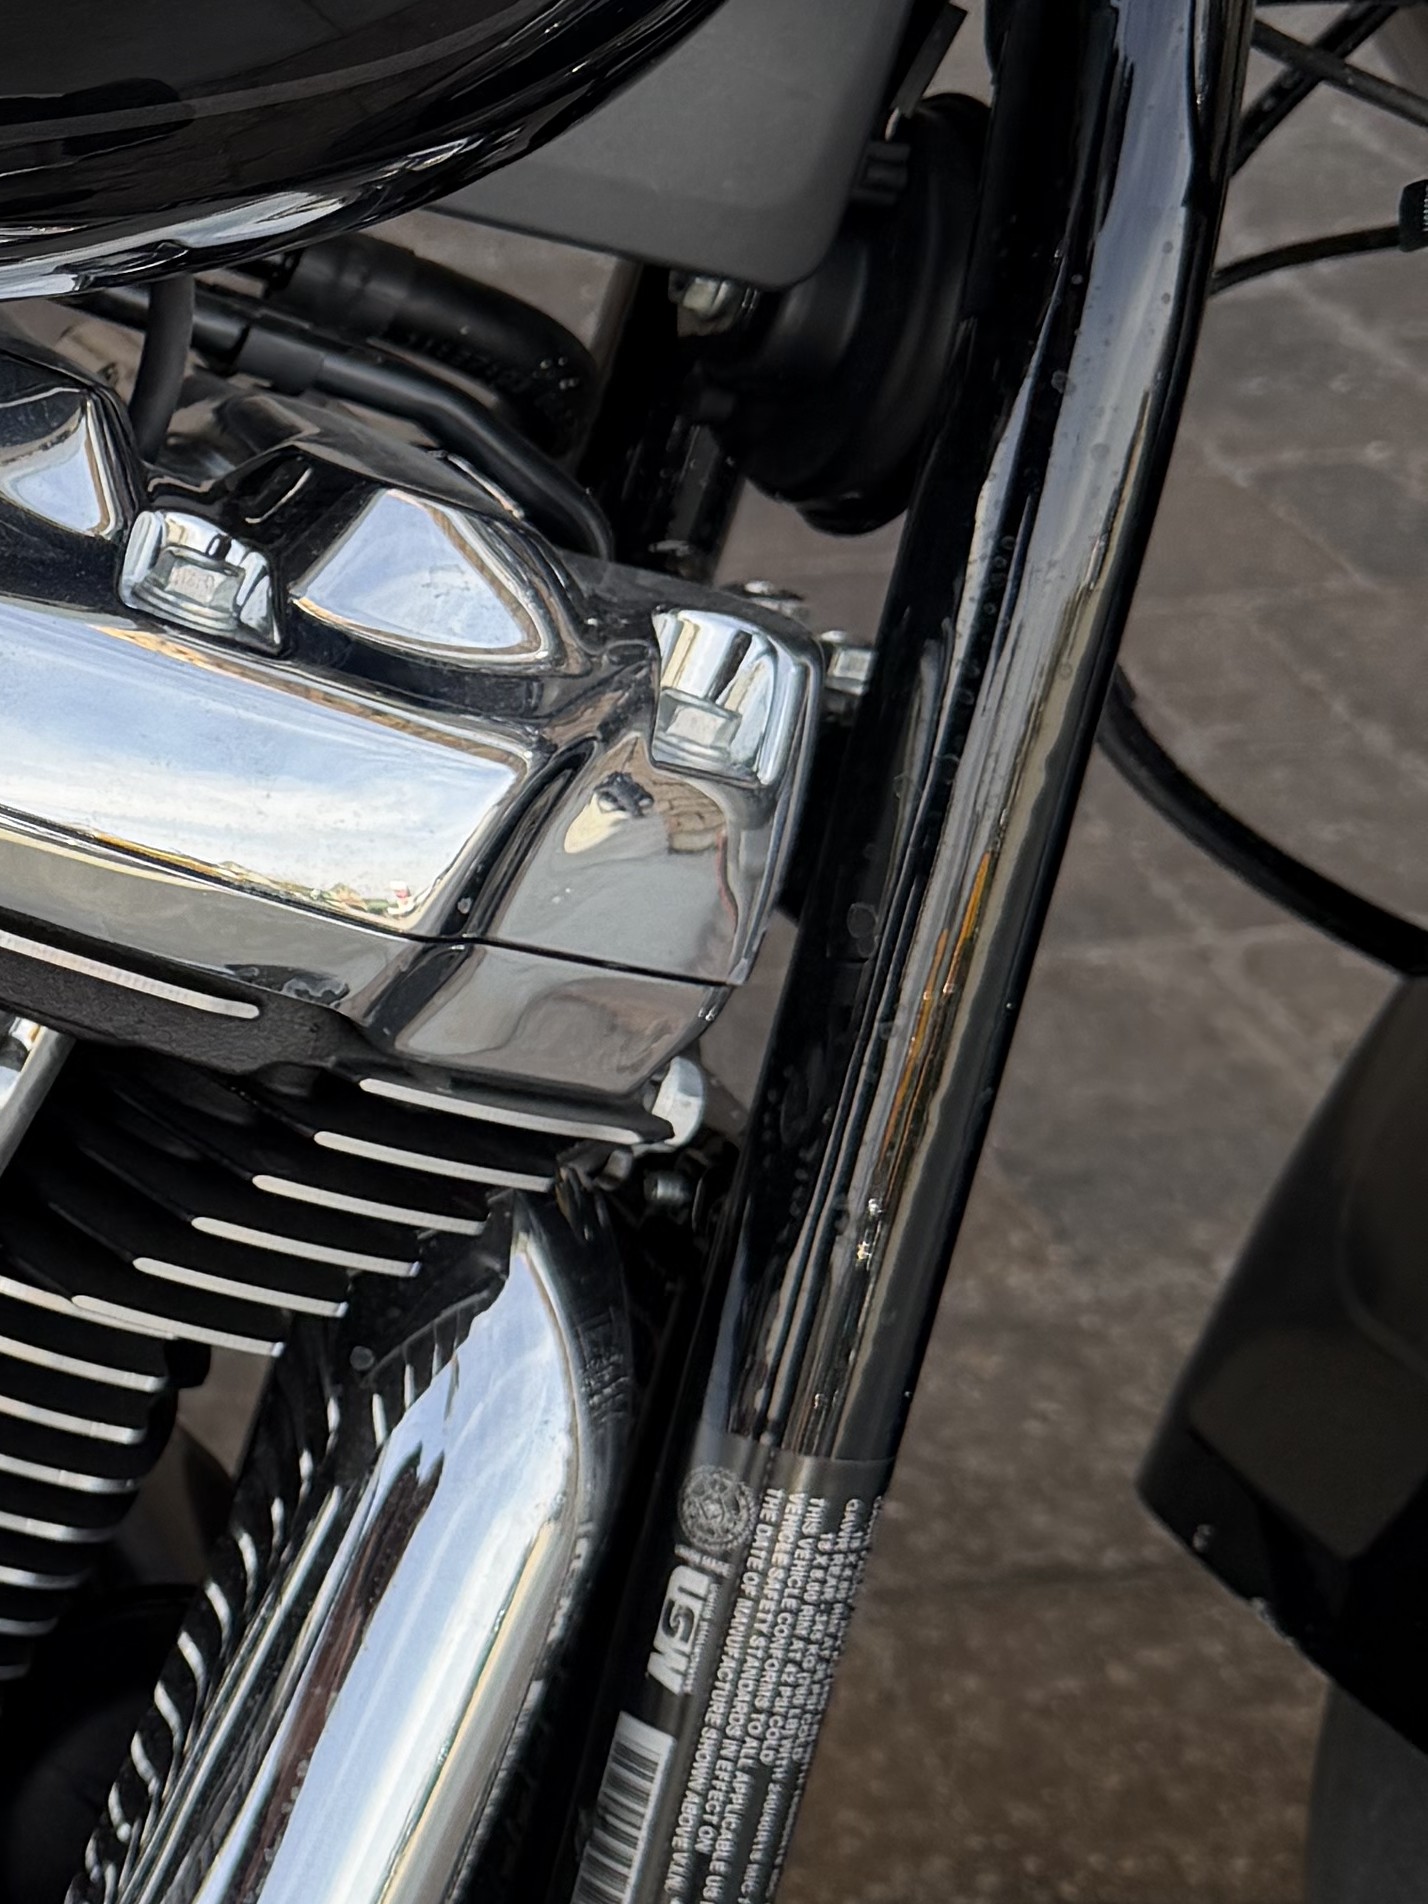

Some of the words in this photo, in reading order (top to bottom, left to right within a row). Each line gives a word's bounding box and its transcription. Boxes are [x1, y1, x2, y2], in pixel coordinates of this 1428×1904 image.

[758, 1485, 784, 1523] THE
[769, 1490, 805, 1567] VEHICLE
[799, 1494, 825, 1536] THIS
[745, 1521, 774, 1572] DATE
[779, 1535, 814, 1611] VEHICLE
[737, 1569, 761, 1599] OF
[751, 1565, 785, 1635] SAFETY
[646, 1565, 712, 1696] USW
[703, 1597, 754, 1728] MANUFACTURE
[752, 1610, 794, 1711] CONFORMS
[723, 1634, 767, 1739] STANDARDS
[718, 1737, 740, 1759] IN
[736, 1735, 761, 1771] ALL
[745, 1710, 768, 1737] TO
[686, 1725, 719, 1792] SHOWN
[700, 1757, 735, 1825] EFFECT
[670, 1789, 702, 1851] ABOVE
[692, 1823, 718, 1854] ON
[708, 1770, 752, 1875] APPLICABLE
